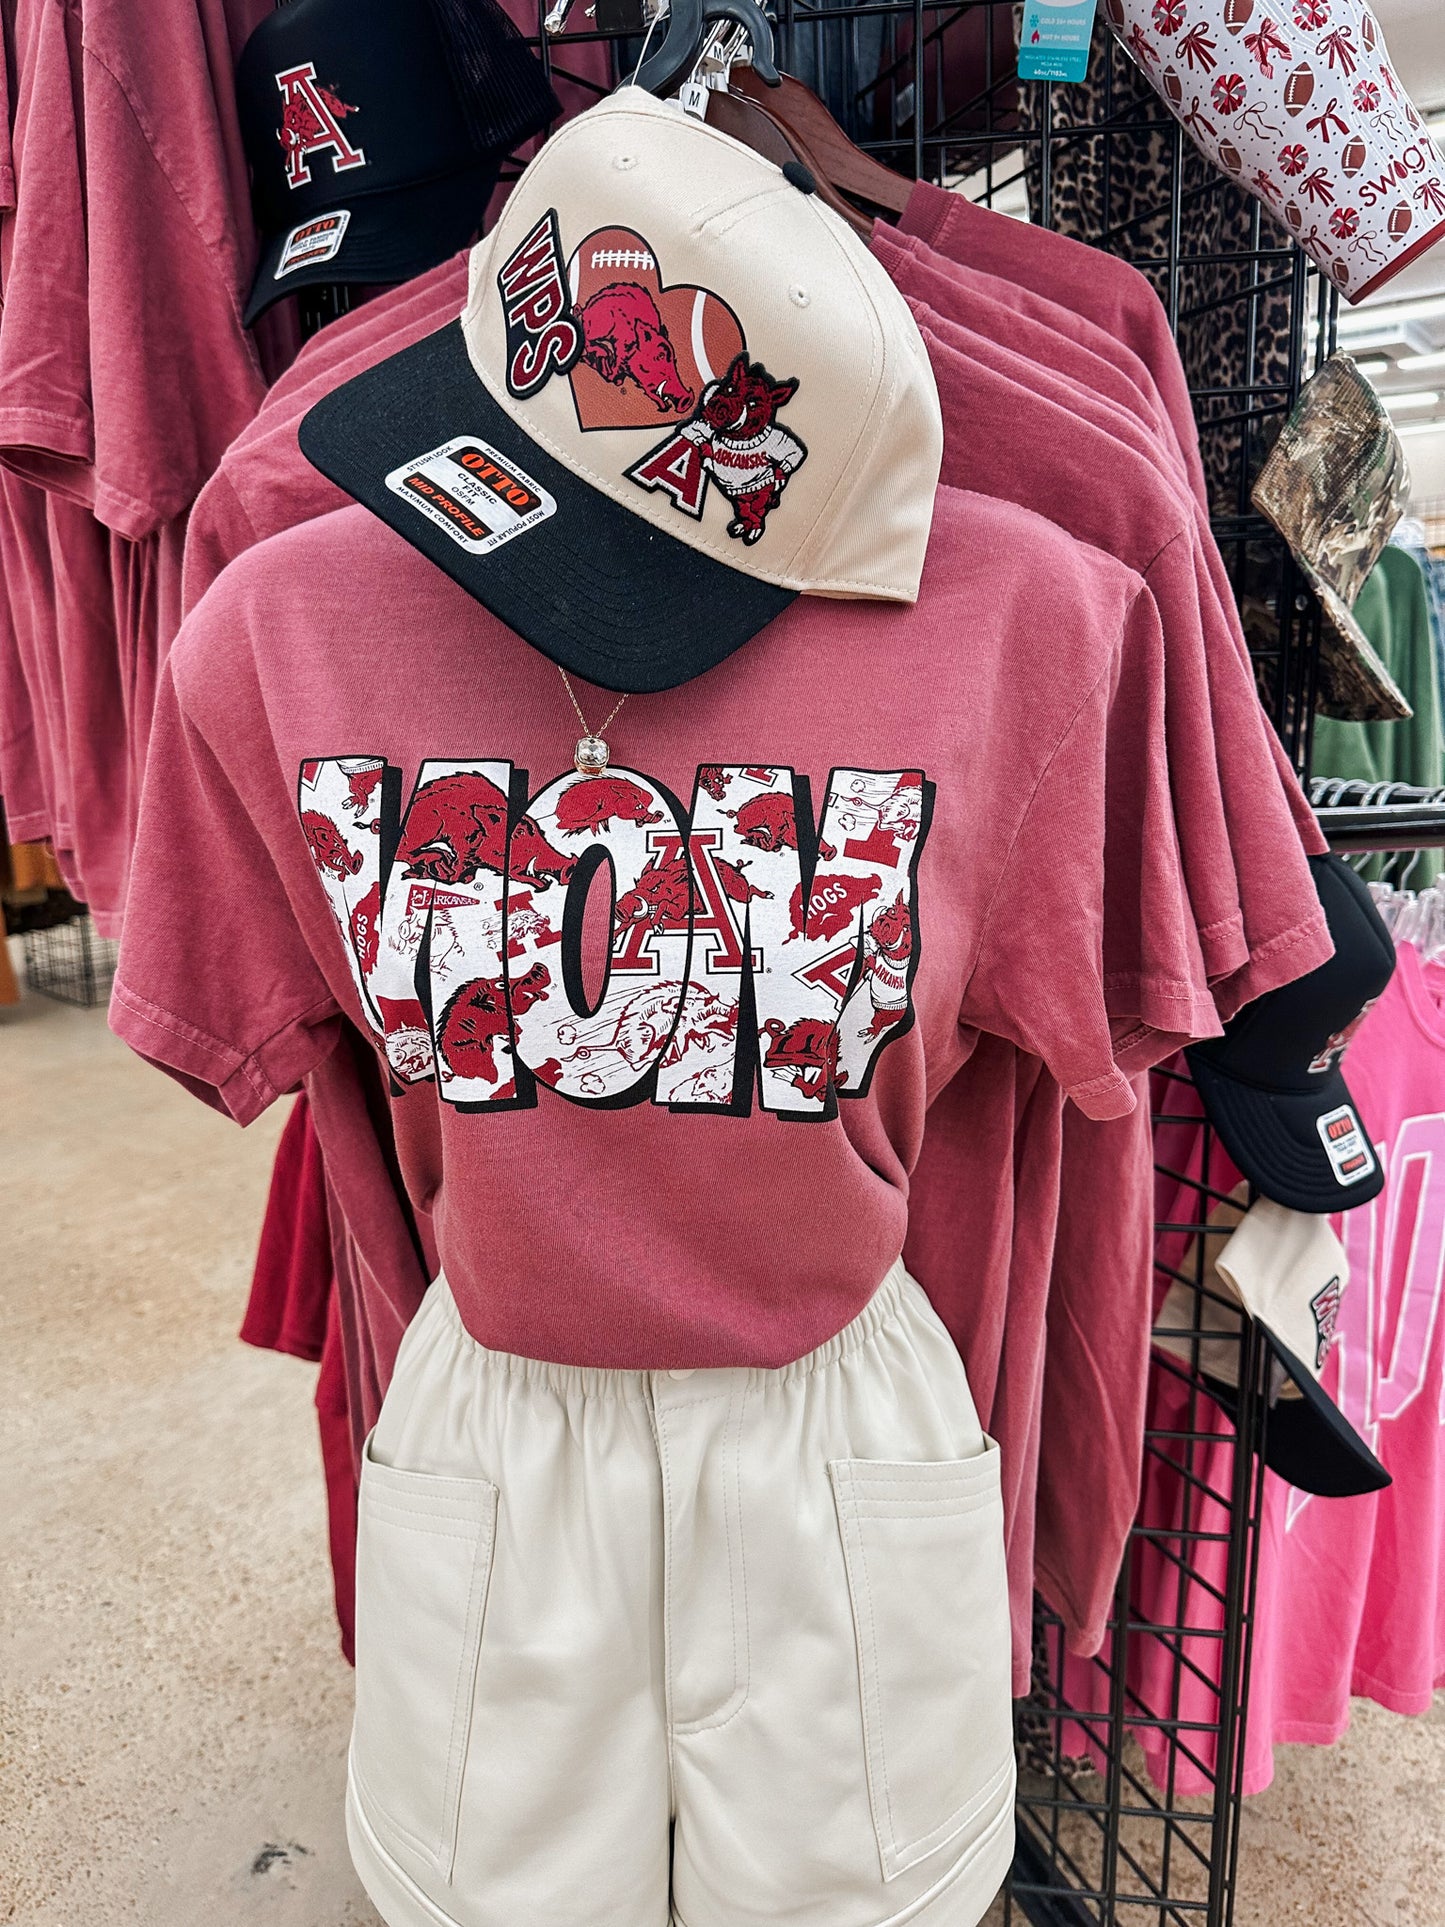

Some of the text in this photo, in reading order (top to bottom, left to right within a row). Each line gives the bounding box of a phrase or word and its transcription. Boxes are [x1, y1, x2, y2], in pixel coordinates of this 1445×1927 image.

[689, 90, 701, 107] M
[295, 218, 336, 243] OTTO
[501, 214, 579, 392] WPS
[406, 445, 454, 472] STYLISH LOOK
[485, 447, 542, 494] PREMIUM FABRIC
[451, 486, 476, 506] OSFM
[457, 472, 498, 505] CLASSIC
[461, 453, 530, 506] OTTO
[462, 485, 480, 498] FIT
[396, 486, 469, 543] MAXIMUM COMFORT
[408, 477, 485, 537] MID PROFILE
[487, 510, 546, 547] MOST POPULAR FIT
[298, 754, 936, 1121] MOM
